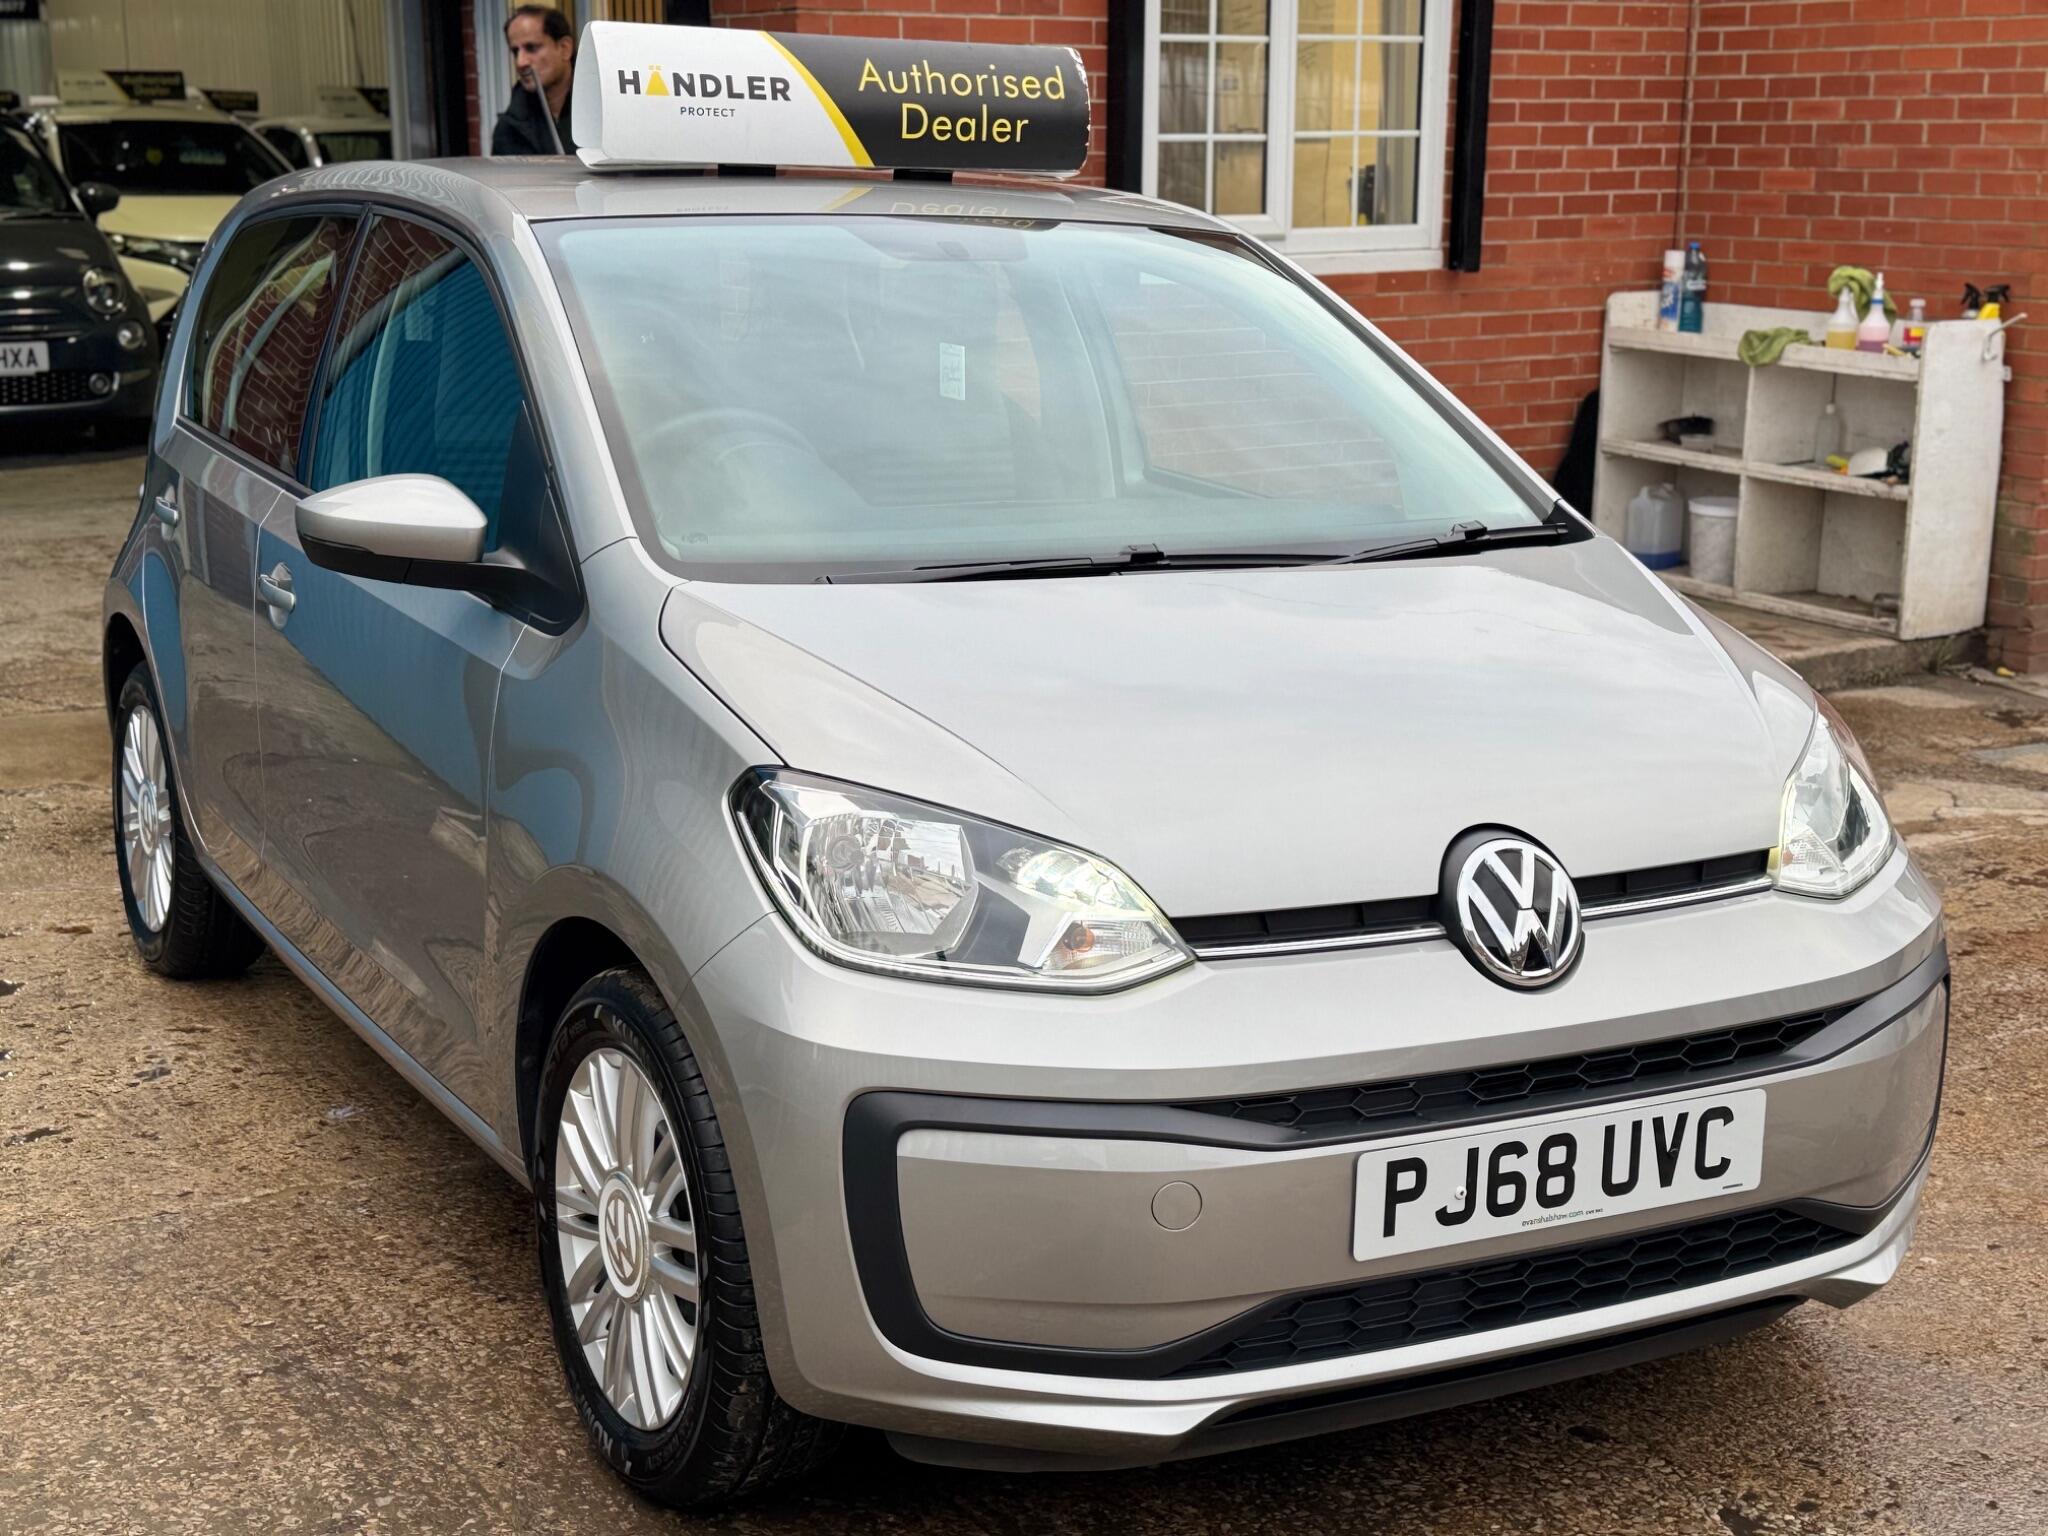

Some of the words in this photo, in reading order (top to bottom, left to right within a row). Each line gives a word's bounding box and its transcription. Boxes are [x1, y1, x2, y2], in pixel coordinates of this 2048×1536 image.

[858, 58, 1065, 100] Authorised
[680, 106, 735, 117] PROTECT
[900, 103, 1029, 142] Dealer
[1383, 1132, 1577, 1238] PJ68
[1601, 1105, 1735, 1197] UVC
